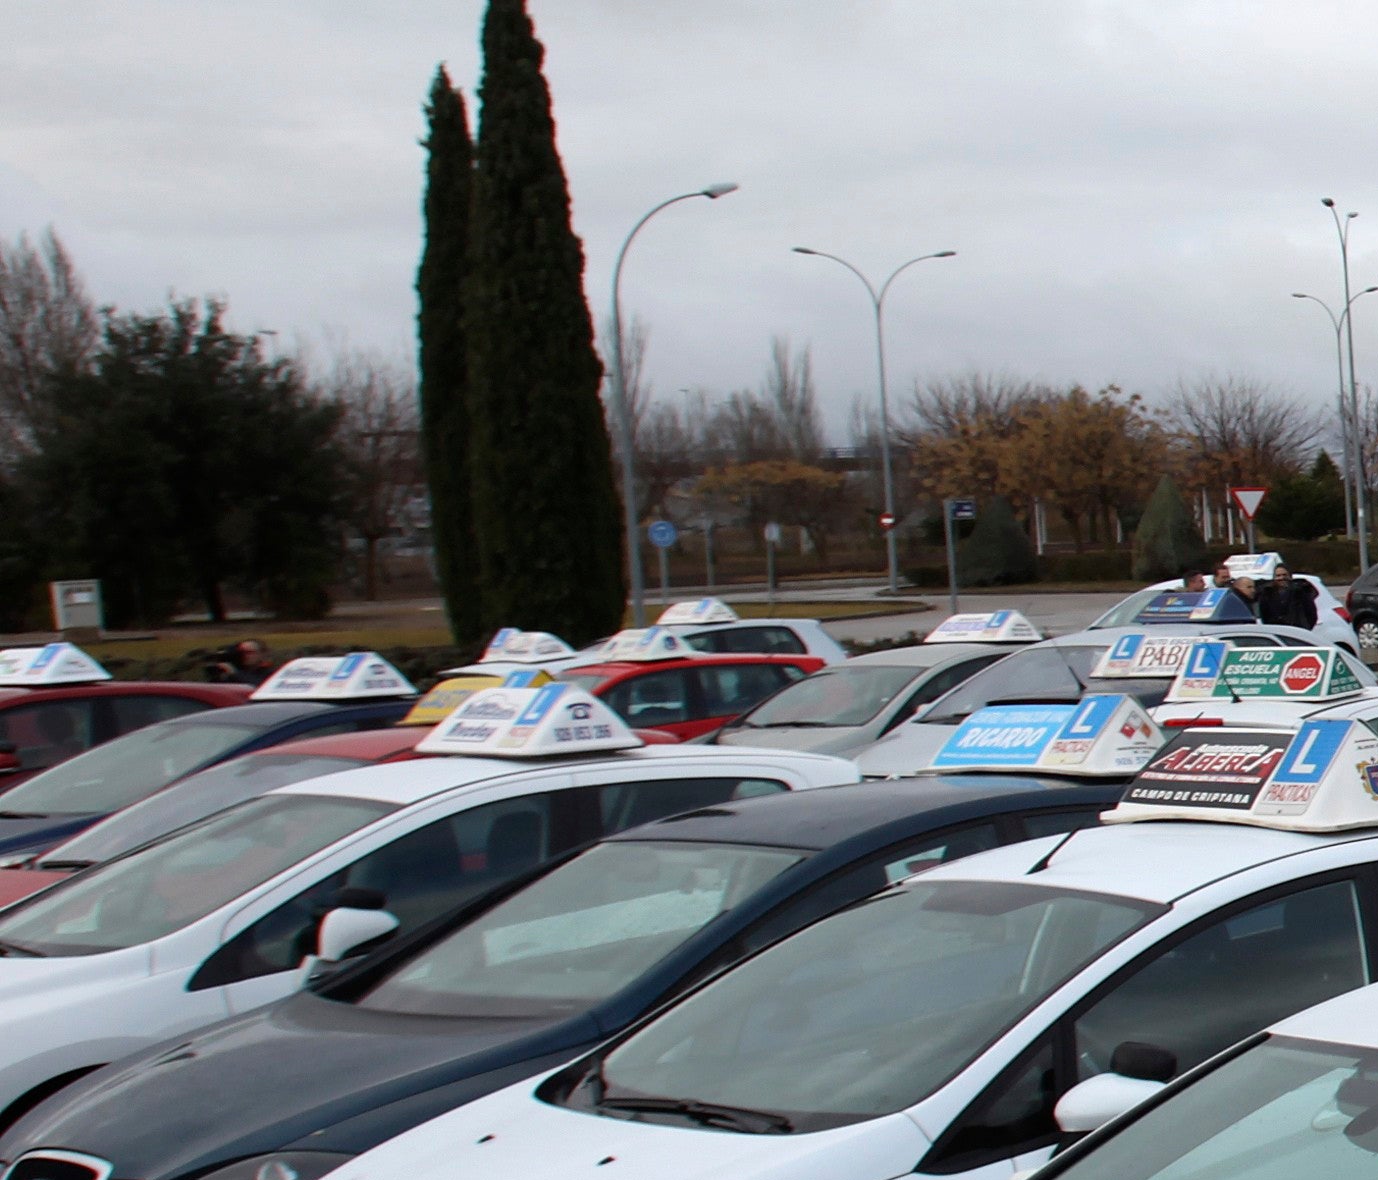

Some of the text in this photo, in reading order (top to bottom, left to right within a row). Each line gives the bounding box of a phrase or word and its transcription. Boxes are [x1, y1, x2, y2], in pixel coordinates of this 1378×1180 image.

[1116, 637, 1131, 657] L
[1238, 651, 1274, 663] AUTO
[1192, 648, 1210, 674] L
[1224, 664, 1281, 675] ESCUELA
[1285, 668, 1318, 680] ANGEL
[1070, 701, 1098, 734] L
[957, 727, 1048, 748] RICARDO
[1289, 729, 1320, 774] L
[1131, 787, 1251, 804] CAMPO DE CRIPTANA
[1266, 783, 1318, 803] PRACTICAS
